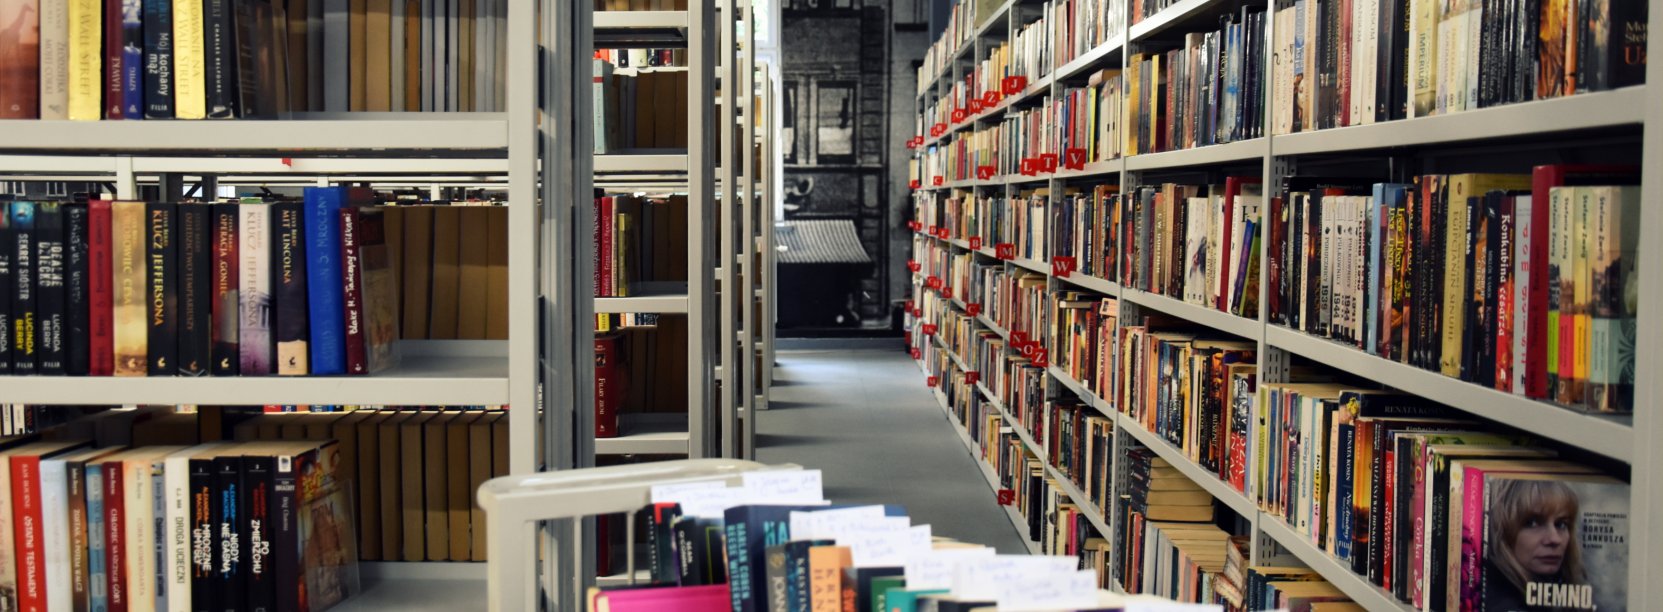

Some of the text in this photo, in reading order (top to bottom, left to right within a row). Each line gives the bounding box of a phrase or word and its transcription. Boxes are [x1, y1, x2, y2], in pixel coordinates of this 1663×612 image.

[79, 53, 91, 97] STREET
[111, 56, 121, 92] HAWKE
[146, 53, 158, 75] mąż
[158, 32, 169, 96] Mój kochany
[178, 54, 189, 97] STREET
[1418, 32, 1426, 90] IMPERIUM
[1011, 79, 1018, 89] J
[972, 101, 982, 110] W
[1023, 161, 1033, 172] L
[1043, 157, 1054, 168] T
[1069, 152, 1082, 165] V
[220, 213, 229, 257] OPERACJA
[282, 209, 293, 284] MIT LINCOLNA
[972, 239, 979, 248] B
[1001, 247, 1013, 257] M
[18, 233, 30, 300] SEKRET SIÓSTR
[51, 241, 63, 287] IDEALNE
[152, 209, 165, 327] KLUCZ JEFFERSONA
[247, 211, 257, 328] KLUCZ JEFFERSONA
[1055, 261, 1070, 273] W
[1448, 210, 1459, 342] EGIPCJANIN SINUHE
[1498, 213, 1511, 337] Konkubina cesarza
[1321, 284, 1329, 310] 1939
[1333, 292, 1341, 319] 1944
[15, 319, 24, 350] BERRY
[25, 312, 34, 356] LUCINDA
[43, 319, 52, 349] BERRY
[52, 314, 61, 353] LUCINDA
[1012, 334, 1021, 344] N
[1023, 344, 1034, 355] O
[1034, 351, 1045, 364] Z
[1001, 491, 1009, 503] S
[251, 519, 262, 574] ZMIERZCHU
[727, 525, 738, 557] REESE
[736, 522, 747, 563] HARLAN
[1414, 516, 1424, 560] Córka
[1583, 525, 1614, 534] BORYSA
[24, 515, 37, 598] OSTATNI TESTAMENT
[174, 516, 186, 584] DROGA UCIECZKI
[202, 523, 212, 571] MROCZNE
[220, 522, 231, 574] NIE GASNĄ
[230, 533, 240, 564] NIGDY
[261, 541, 270, 555] PO
[1525, 581, 1597, 611] CIEMNO,
